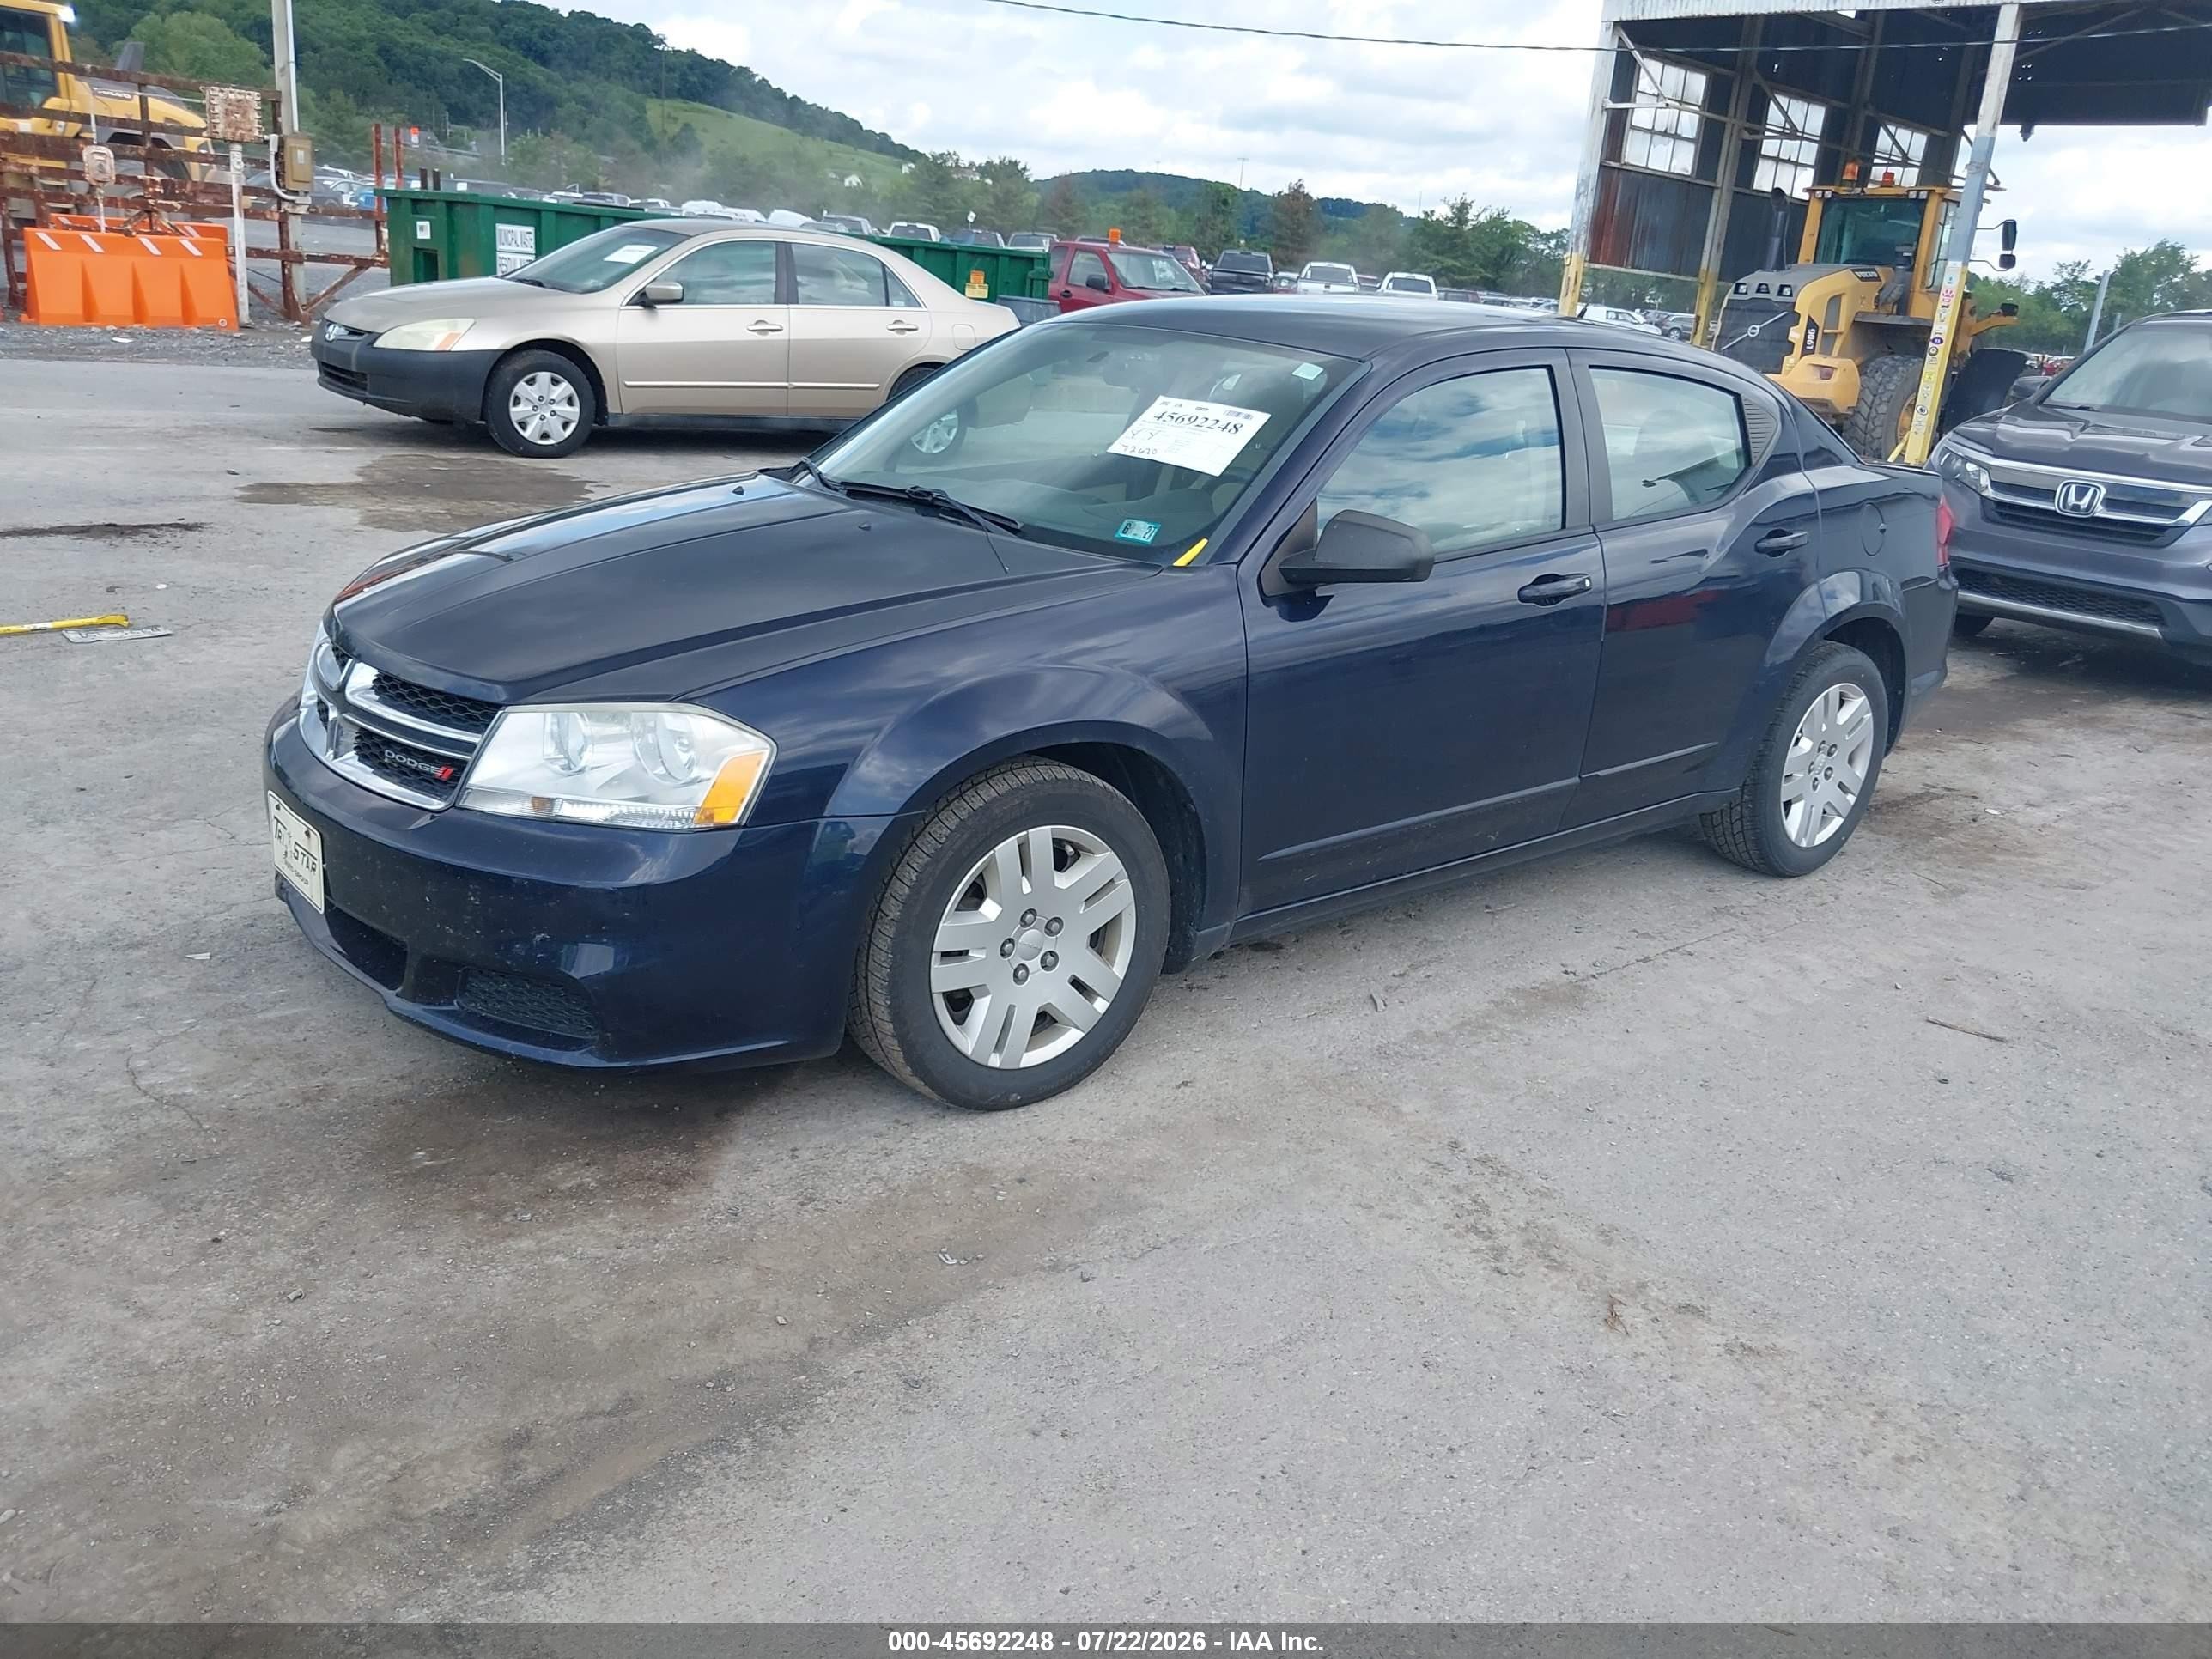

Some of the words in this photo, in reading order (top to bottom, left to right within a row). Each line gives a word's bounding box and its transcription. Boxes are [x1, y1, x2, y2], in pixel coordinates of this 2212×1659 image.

[1153, 410, 1243, 434] 45692248
[384, 749, 443, 776] DODGE
[293, 841, 318, 875] STAR
